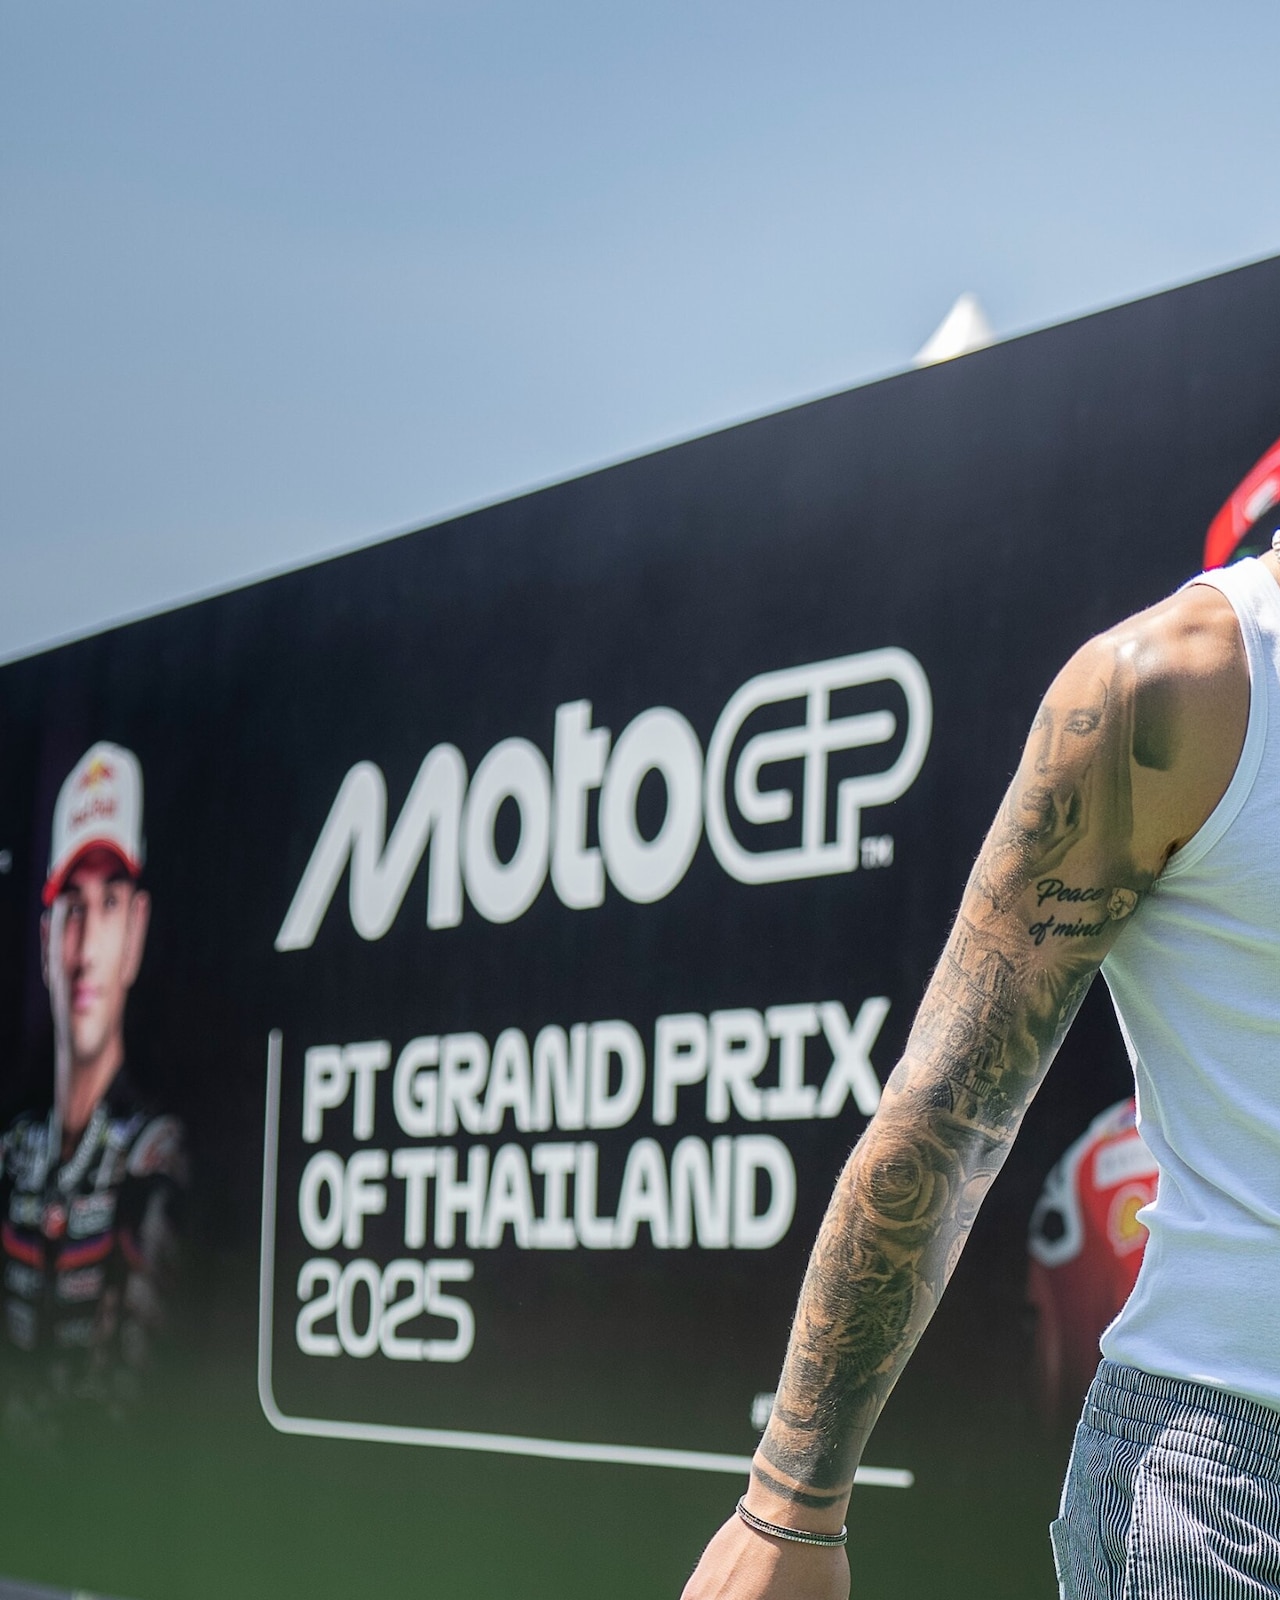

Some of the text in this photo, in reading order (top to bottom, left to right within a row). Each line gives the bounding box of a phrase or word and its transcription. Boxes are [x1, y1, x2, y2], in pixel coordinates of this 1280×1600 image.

[1028, 915, 1111, 946] of mind
[1036, 878, 1104, 907] Peace
[302, 996, 892, 1143] PT GRAND PRIX
[297, 1134, 799, 1251] OF THAILAND
[295, 1258, 476, 1362] 2025
